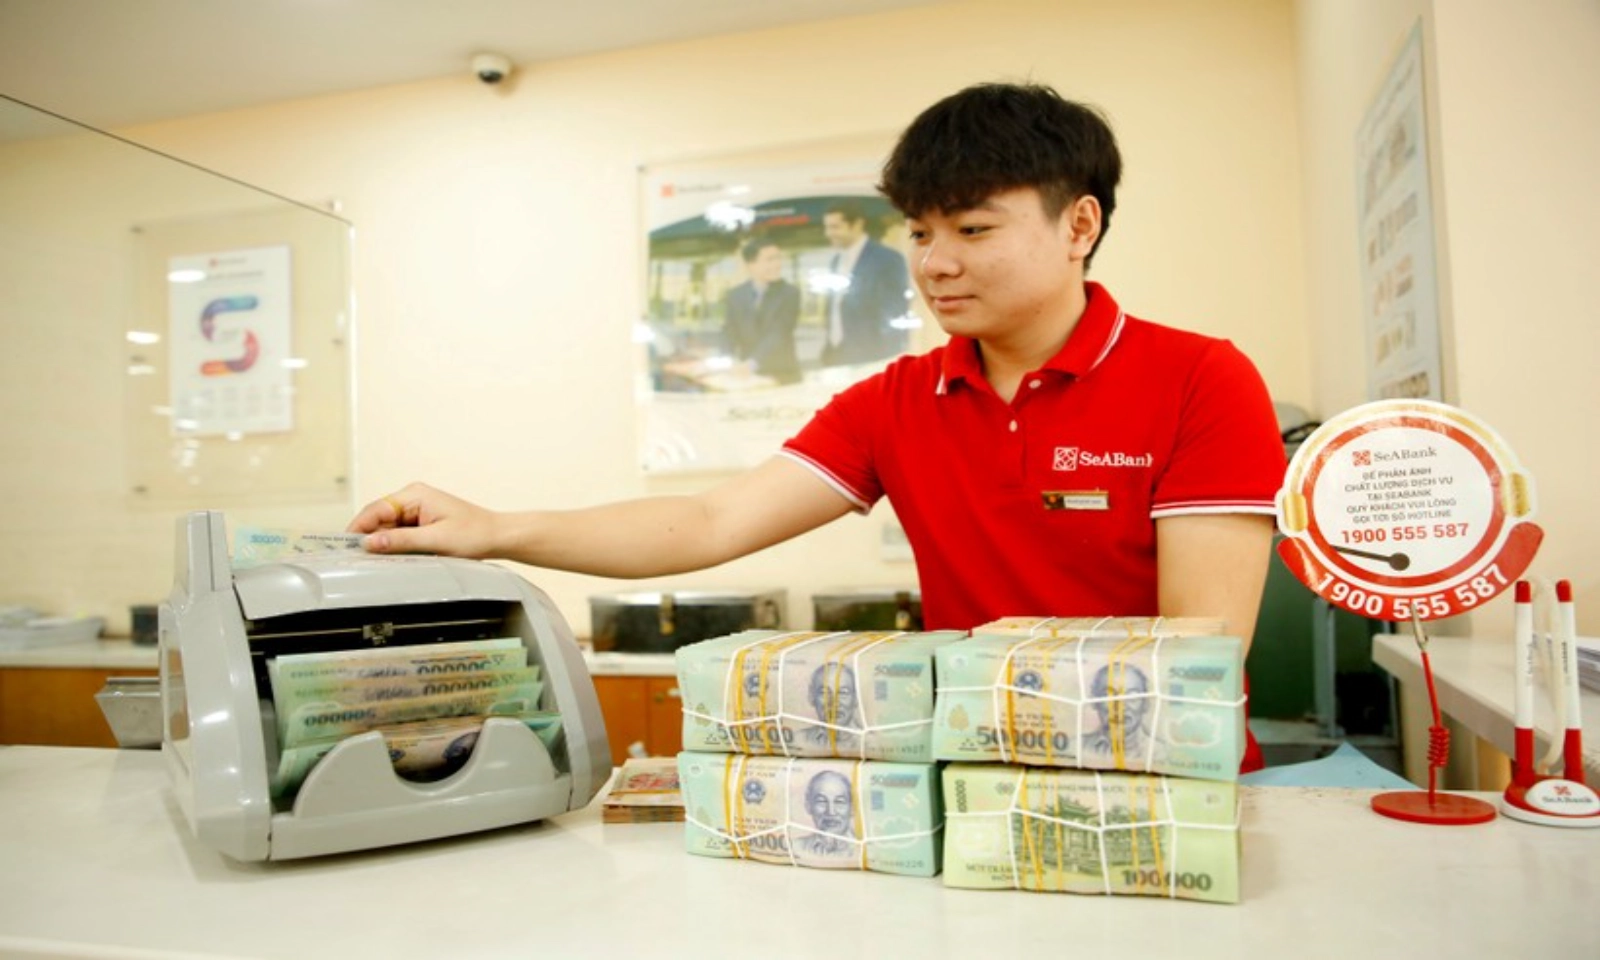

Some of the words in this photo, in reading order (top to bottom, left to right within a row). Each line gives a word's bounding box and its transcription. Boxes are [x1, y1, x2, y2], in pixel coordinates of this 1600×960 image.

[1373, 446, 1437, 462] SeABank
[1385, 489, 1431, 501] SEABANK
[1408, 508, 1451, 520] HOTLINE
[1342, 527, 1386, 543] 1900
[1392, 525, 1427, 541] 555
[1433, 522, 1469, 538] 587
[1316, 572, 1383, 616] 1900
[1393, 593, 1450, 619] 555
[1455, 563, 1508, 607] 587
[1122, 868, 1213, 892] 100000
